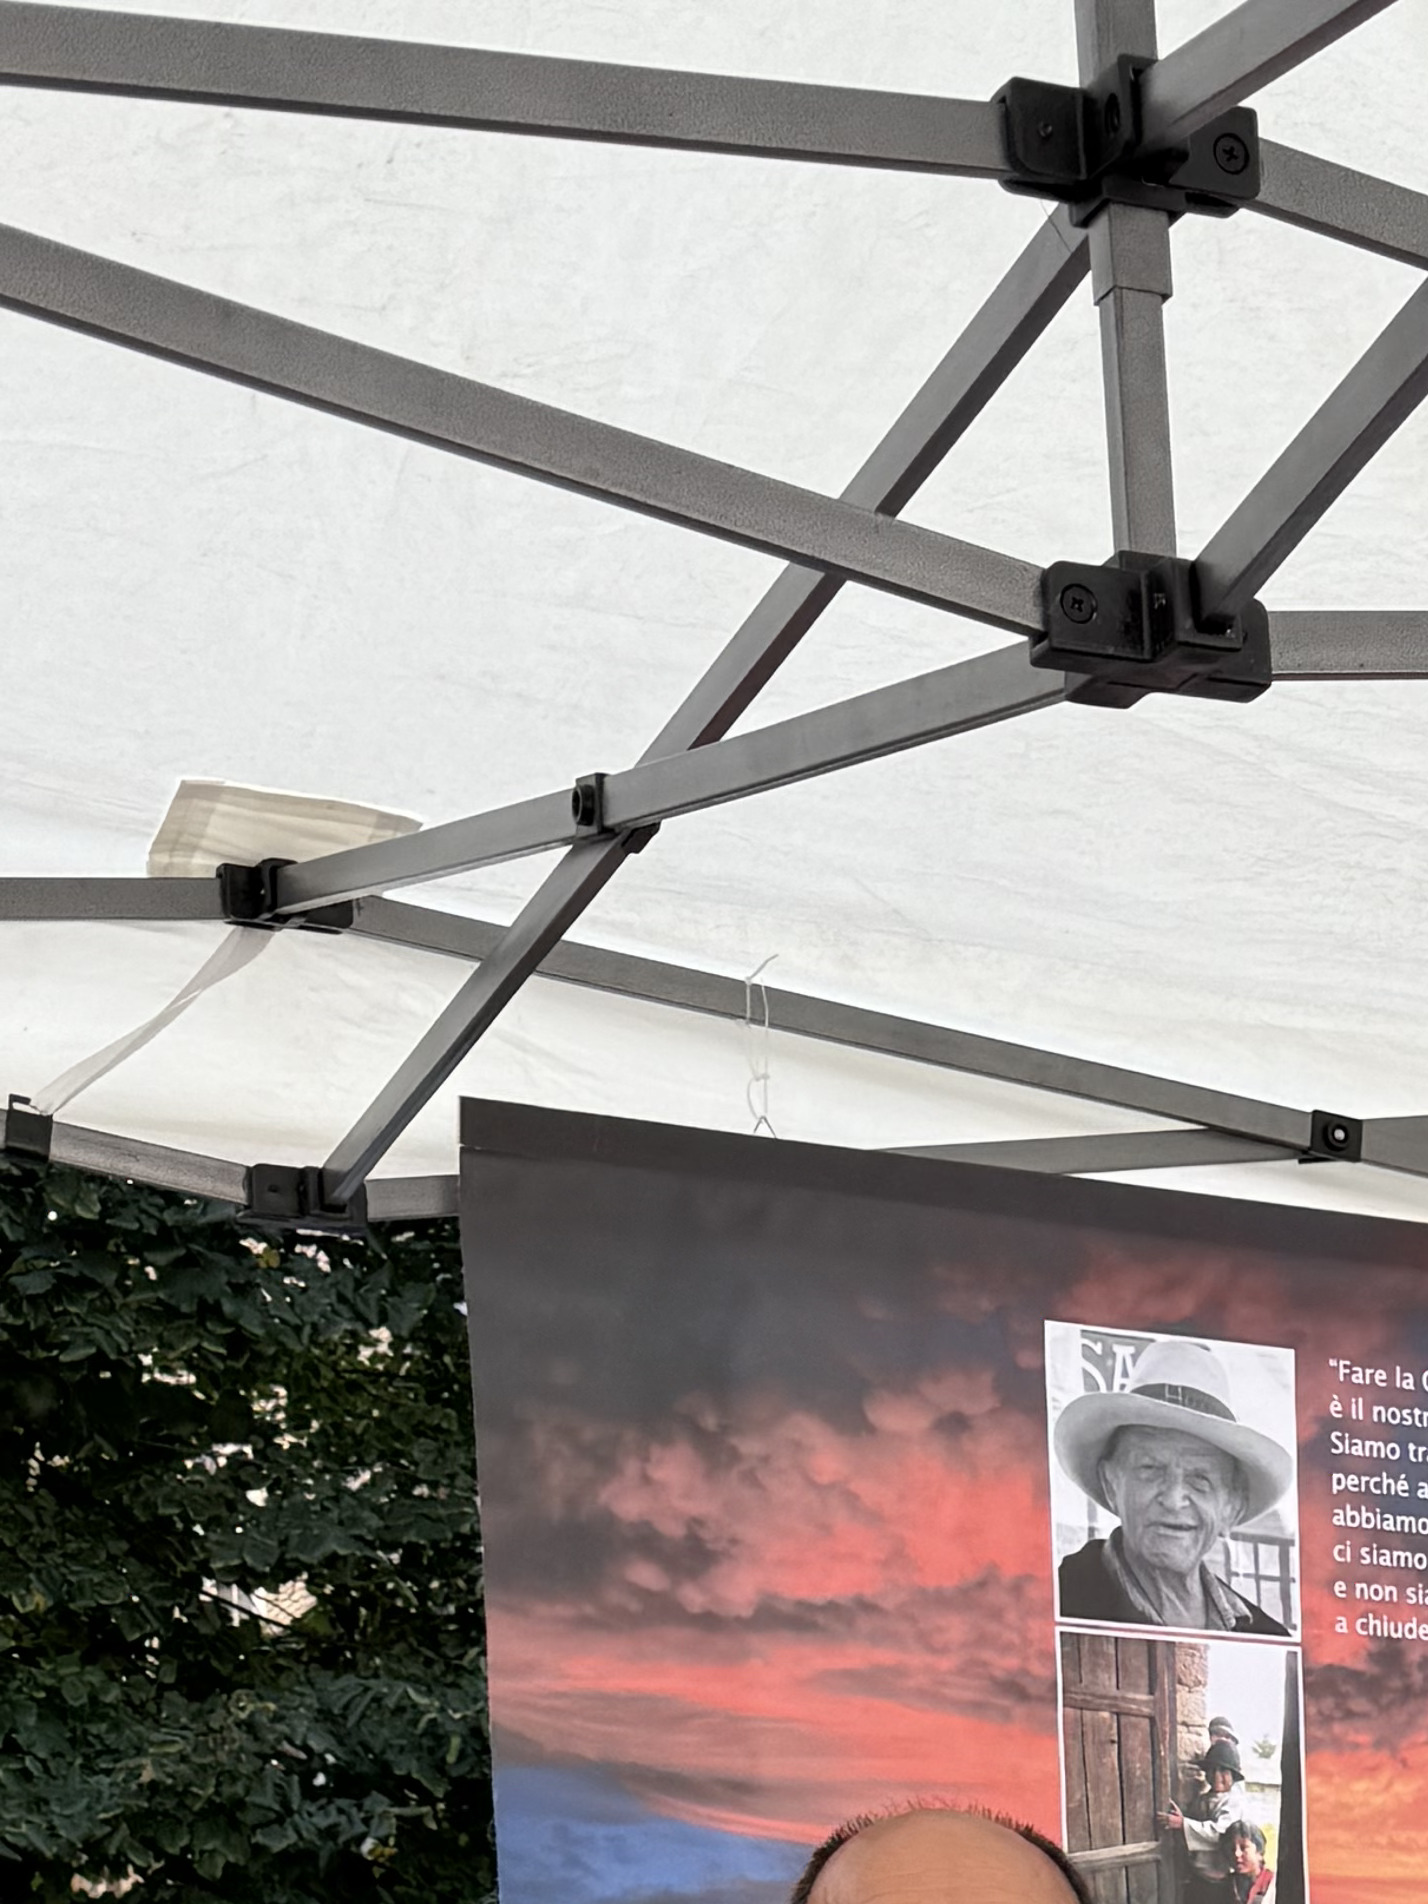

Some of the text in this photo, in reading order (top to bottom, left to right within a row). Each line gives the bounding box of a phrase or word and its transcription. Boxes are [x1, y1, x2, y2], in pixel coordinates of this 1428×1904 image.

[1395, 1365, 1416, 1391] la
[1328, 1393, 1344, 1419] è
[1350, 1396, 1364, 1421] il
[1329, 1430, 1401, 1461] Siamo
[1331, 1470, 1410, 1498] perché
[1332, 1540, 1352, 1563] ci
[1359, 1542, 1428, 1571] siamo
[1333, 1580, 1347, 1599] e
[1354, 1582, 1399, 1603] non
[1334, 1615, 1349, 1634] a
